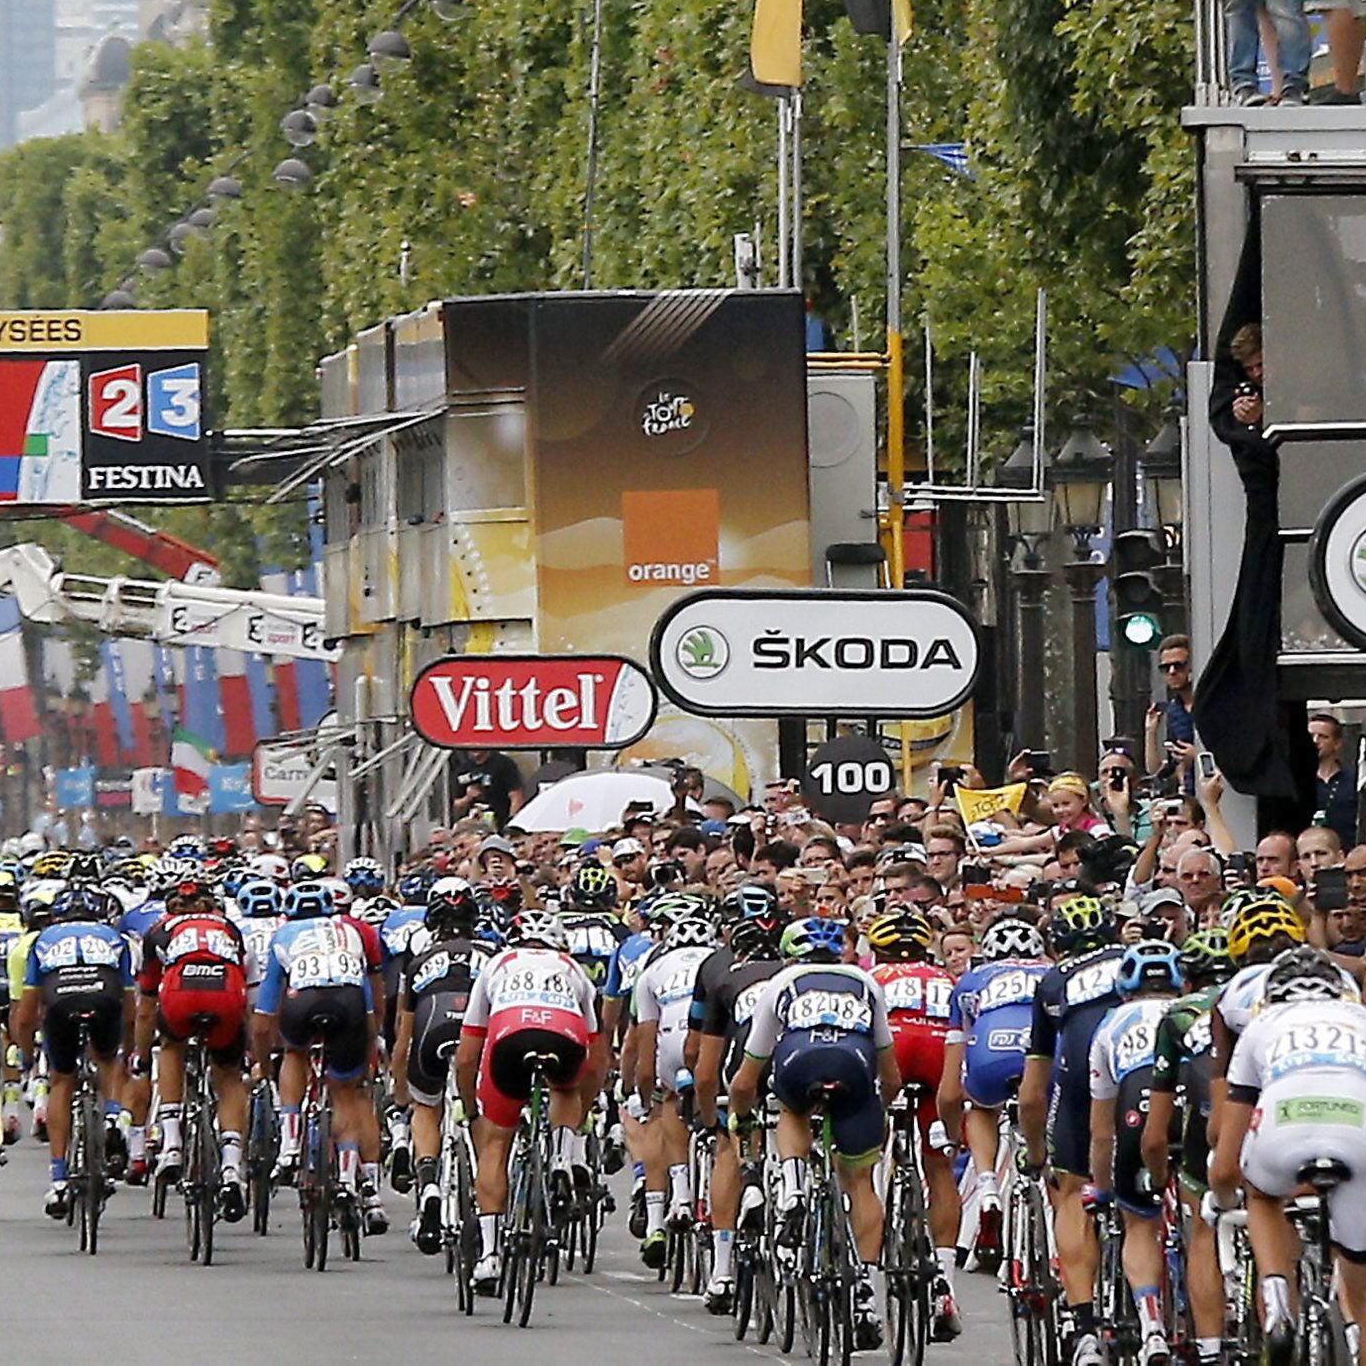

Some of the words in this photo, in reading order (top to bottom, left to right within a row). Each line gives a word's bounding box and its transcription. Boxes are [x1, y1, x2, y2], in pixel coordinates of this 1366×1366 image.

[101, 378, 141, 428] 2
[161, 378, 201, 427] 3
[88, 464, 205, 490] FESTINA
[628, 562, 711, 585] orange
[751, 630, 963, 671] ŠKODA
[429, 674, 599, 732] Vittel
[810, 761, 891, 796] 100
[297, 956, 320, 978] 93
